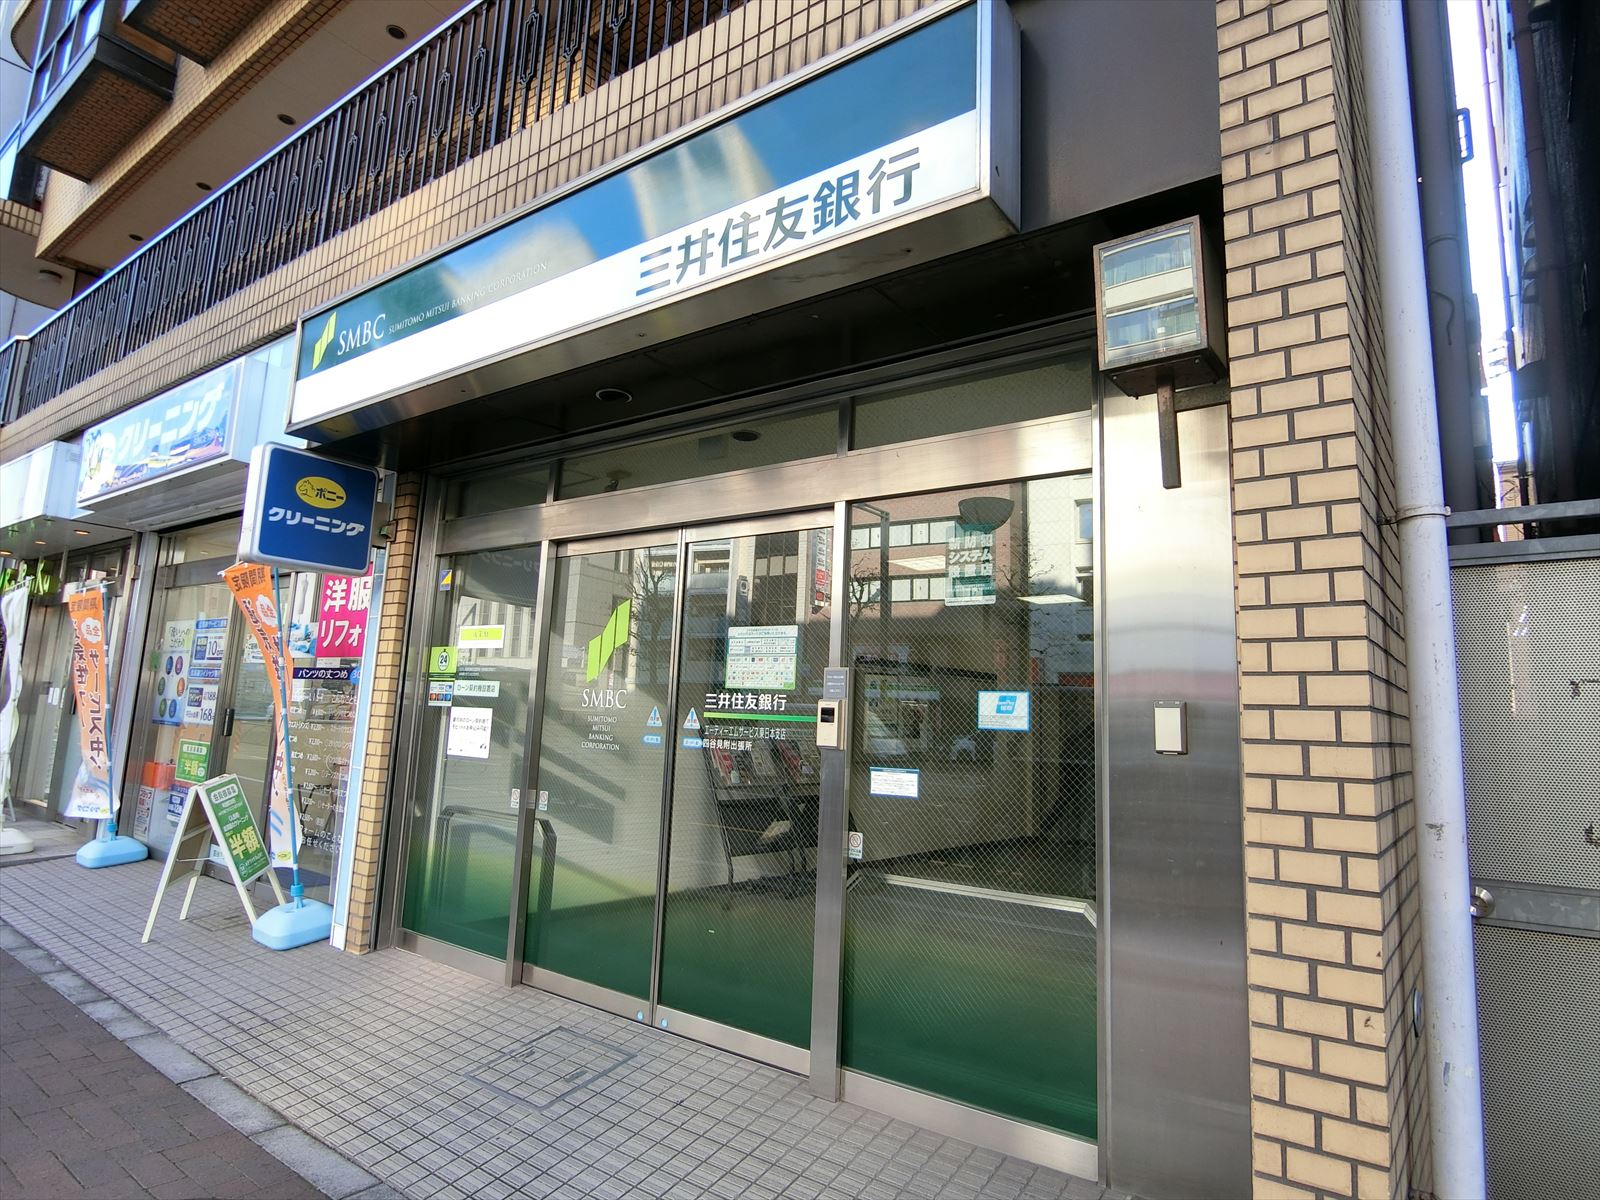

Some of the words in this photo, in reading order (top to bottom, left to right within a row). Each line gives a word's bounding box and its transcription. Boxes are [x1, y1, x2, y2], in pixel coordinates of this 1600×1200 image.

[635, 146, 920, 297] 三井住友銀行
[337, 313, 387, 356] SMBC
[388, 312, 425, 335] SUMITOMO
[425, 301, 450, 322] MITSUI
[451, 286, 486, 309] BANKING
[487, 261, 549, 294] CORPORATION
[116, 381, 225, 458] クリーニング
[315, 487, 345, 503] ポニー
[267, 506, 366, 537] クリーニング
[949, 550, 993, 564] システム
[320, 618, 362, 648] リフォ
[440, 655, 448, 664] 24
[298, 668, 349, 679] パンツの丈つめ
[581, 688, 628, 709] SMBC
[704, 692, 787, 711] 三井住友銀行
[587, 715, 618, 723] SUMITOMO
[588, 733, 614, 741] BANKING
[704, 725, 787, 740] エーティーエムサービス東日本支店
[581, 741, 620, 751] CORPORATION
[702, 738, 753, 751] 四谷見附出張所
[229, 825, 261, 859] 半額
